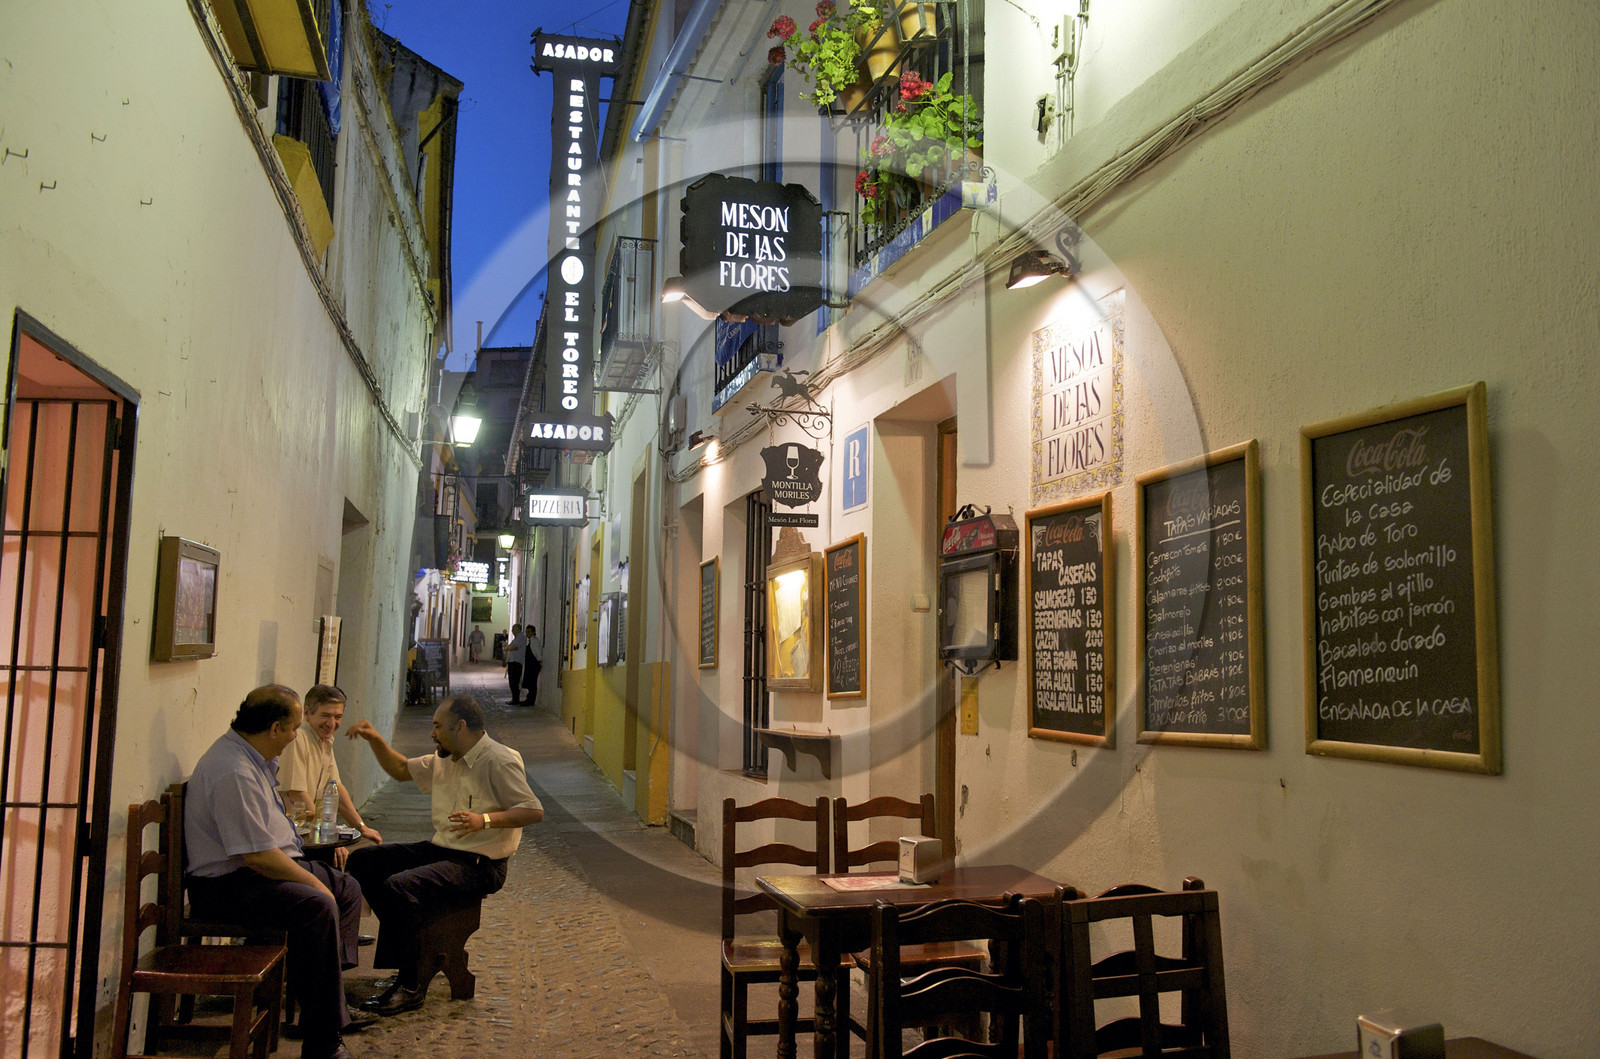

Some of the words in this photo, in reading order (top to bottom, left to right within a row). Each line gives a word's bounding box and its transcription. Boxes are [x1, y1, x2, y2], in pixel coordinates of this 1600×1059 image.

[542, 43, 614, 63] ASADOR
[565, 79, 584, 250] RESTAURANTE
[721, 201, 789, 233] MESON
[726, 232, 749, 258] DE
[755, 234, 786, 263] LAS
[720, 261, 790, 292] FLORES
[564, 291, 580, 322] EL
[561, 332, 580, 410] TOREO
[1053, 388, 1072, 431] DE
[1075, 375, 1102, 427] LAS
[530, 423, 604, 441] ASADOR
[848, 439, 861, 480] R
[1048, 421, 1105, 478] FLORES
[772, 480, 813, 491] MONTILLA
[1322, 466, 1428, 507] Especialidad
[1430, 458, 1452, 485] de
[531, 499, 581, 514] PIZZERIA
[774, 490, 810, 500] MORILES
[1164, 514, 1195, 537] TAPAS
[1360, 523, 1377, 546] de
[1383, 522, 1418, 543] Toro
[1037, 549, 1063, 571] TAPAS
[1317, 559, 1359, 585] Puntas
[1363, 552, 1379, 575] de
[1058, 562, 1096, 586] CASERAS
[1035, 587, 1075, 610] SALMOREJO
[1146, 588, 1188, 606] Calamares
[1319, 587, 1377, 611] Gambas
[1381, 582, 1393, 601] al
[1397, 573, 1433, 602] ajillo
[1147, 605, 1191, 625] Salmorejo
[1320, 606, 1379, 636] habitas
[1382, 606, 1404, 623] con
[1409, 596, 1455, 627] jamón
[1149, 642, 1176, 659] Chorizo
[1178, 639, 1186, 650] al
[1391, 625, 1446, 651] dorado
[1036, 651, 1052, 670] PAPA
[1053, 651, 1078, 670] BRAVA
[1036, 671, 1053, 690] PAPA
[1036, 690, 1084, 713] ENSALADILLA
[1432, 697, 1473, 716] CASA
